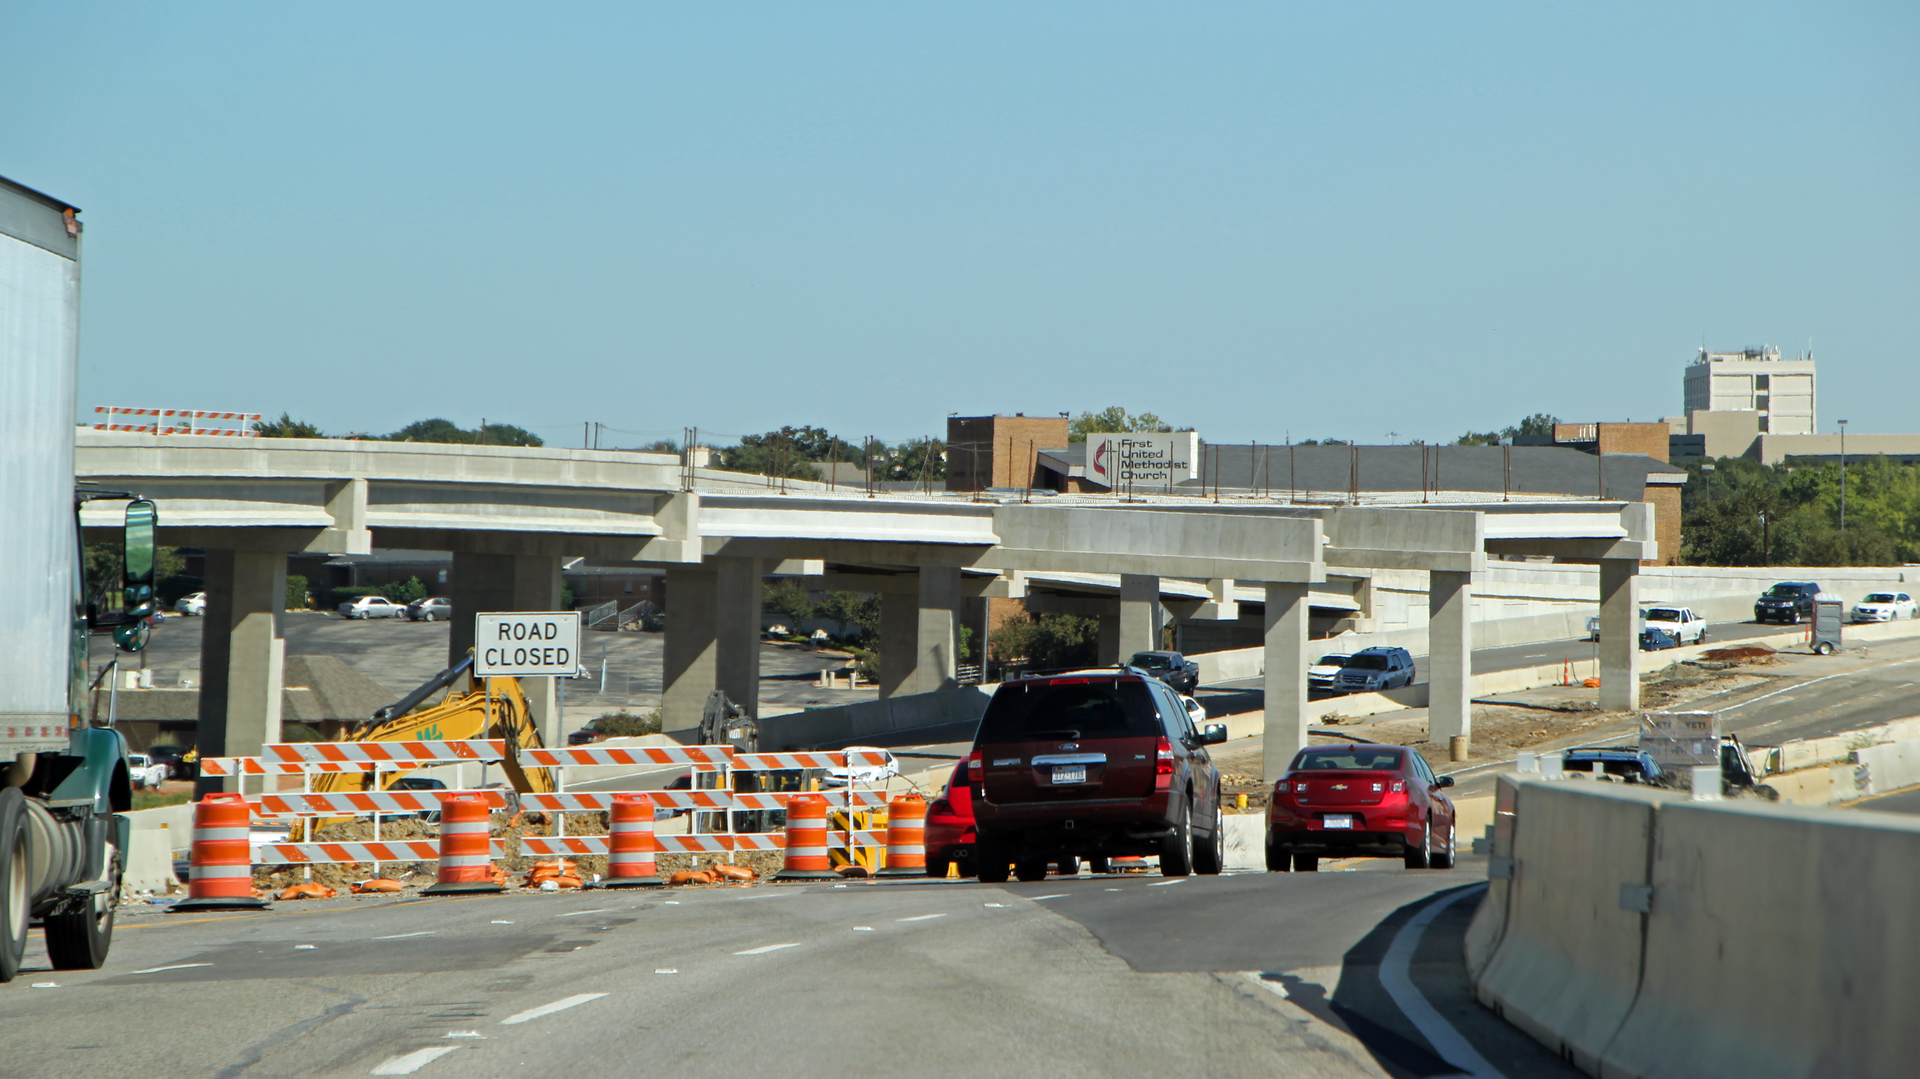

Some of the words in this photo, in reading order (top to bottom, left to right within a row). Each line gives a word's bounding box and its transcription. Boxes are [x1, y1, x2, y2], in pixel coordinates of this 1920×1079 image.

[1121, 439, 1153, 448] First
[1121, 449, 1164, 459] United
[1121, 460, 1188, 469] Methodst
[1121, 470, 1168, 480] Church
[498, 622, 557, 641] ROAD
[485, 647, 569, 667] CLOSED
[1685, 721, 1706, 729] YETI
